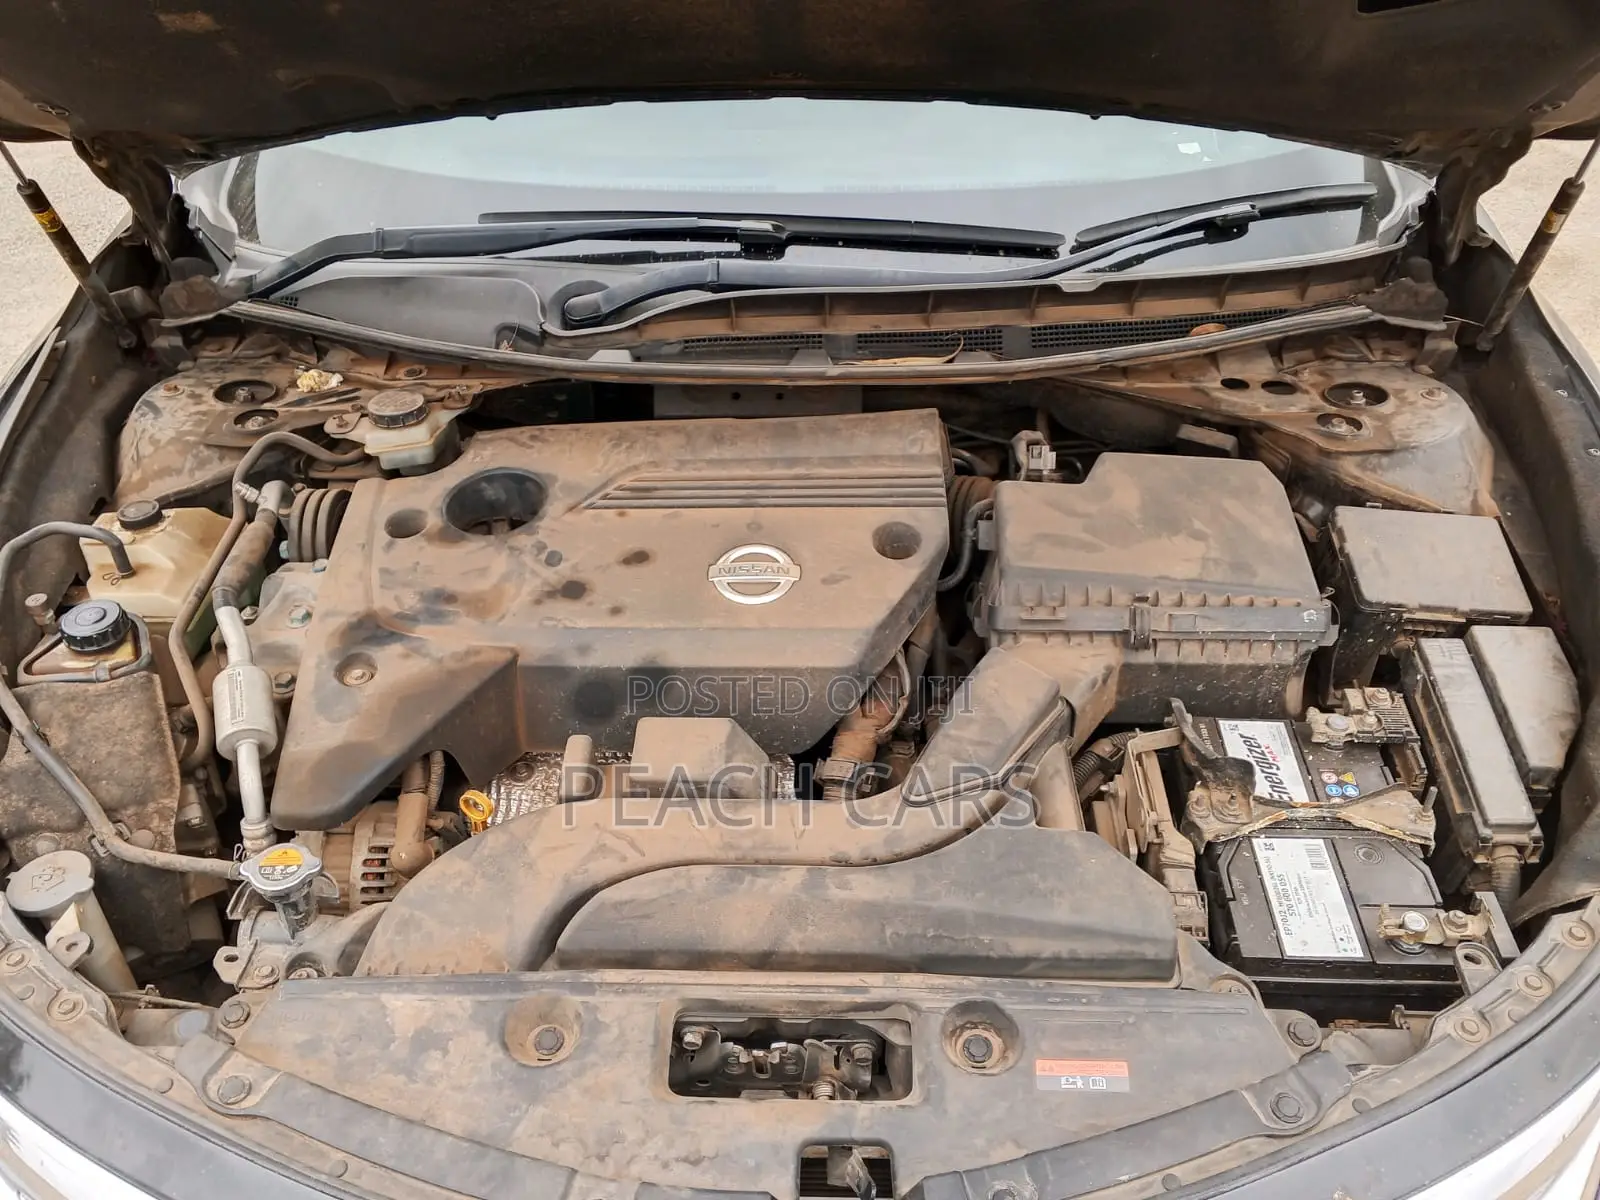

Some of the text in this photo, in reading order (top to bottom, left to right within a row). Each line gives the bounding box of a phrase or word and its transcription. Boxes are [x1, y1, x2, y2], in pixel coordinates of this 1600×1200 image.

[718, 564, 790, 576] NISSAN
[1263, 743, 1280, 763] MAX
[1238, 733, 1293, 801] Energizer
[1286, 902, 1297, 917] 570
